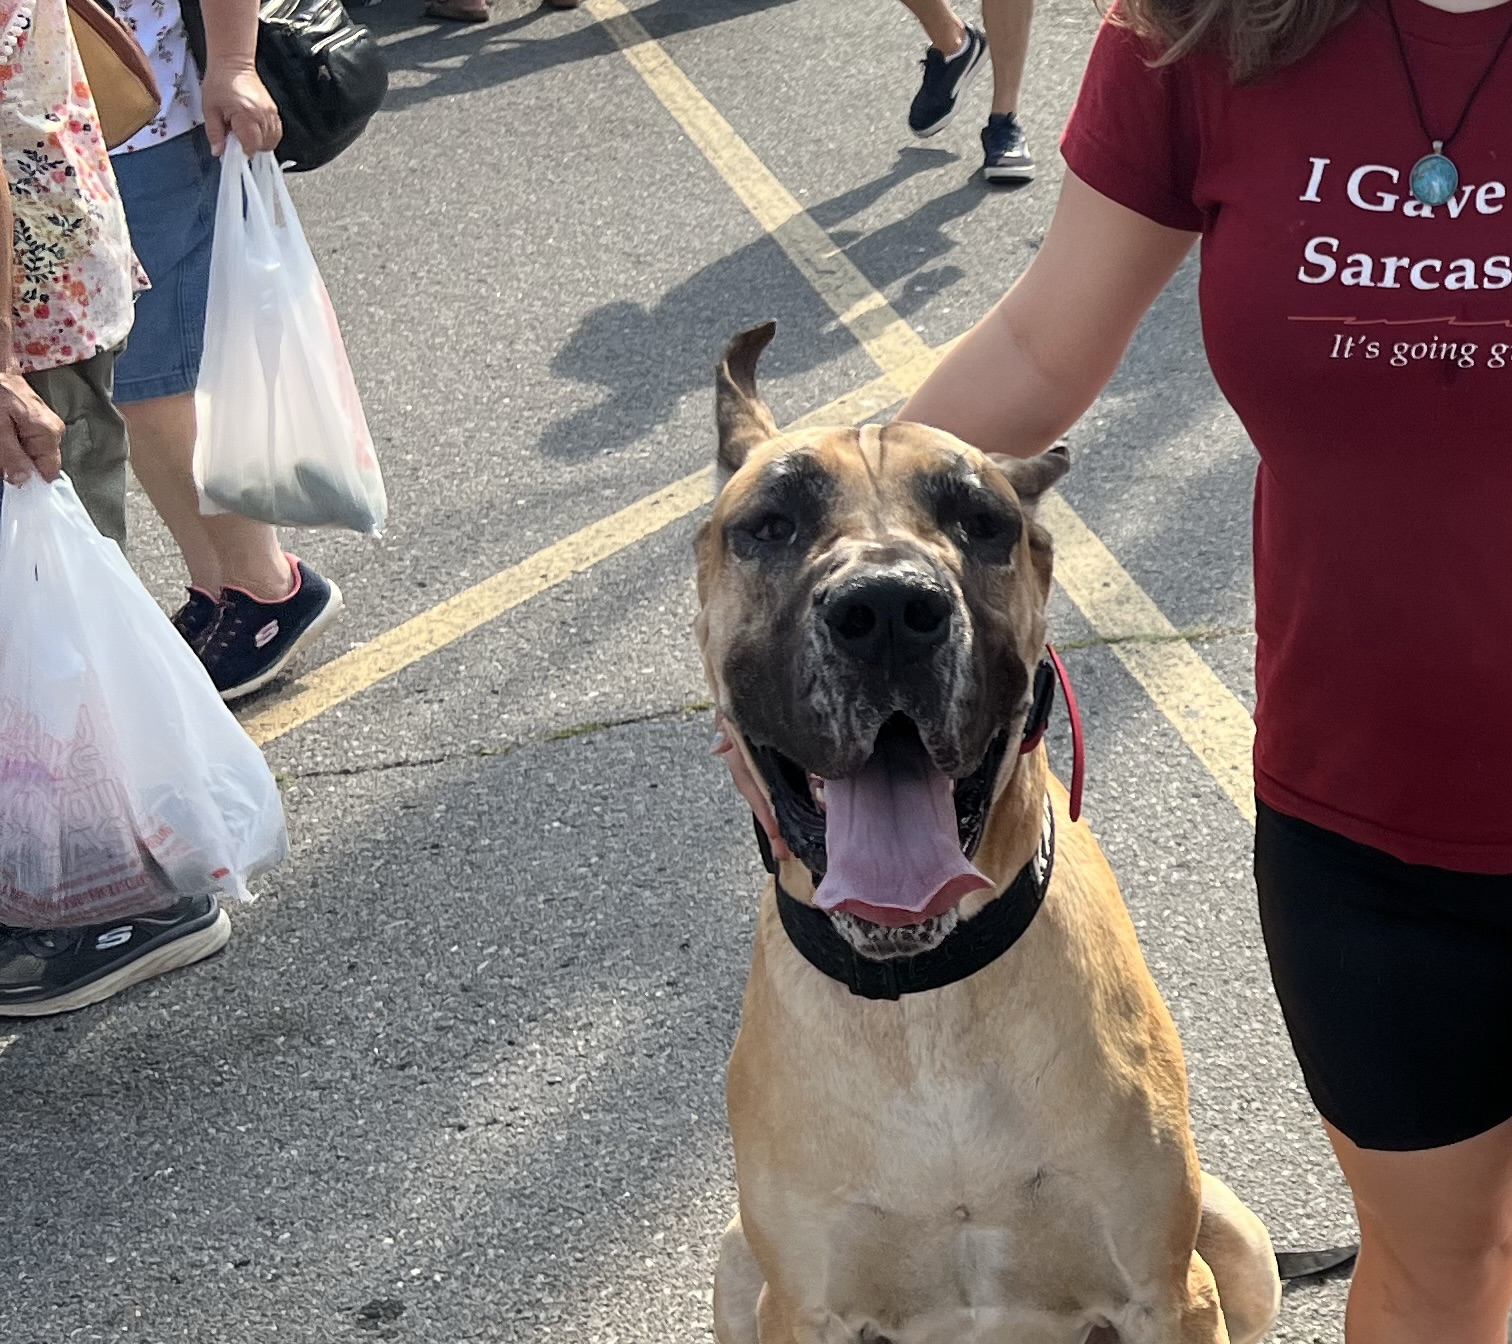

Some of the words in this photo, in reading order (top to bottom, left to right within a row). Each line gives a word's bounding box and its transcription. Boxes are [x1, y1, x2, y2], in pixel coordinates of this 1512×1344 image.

[1299, 157, 1331, 203] I
[1346, 164, 1506, 219] Gave
[1330, 333, 1380, 359] It's
[1389, 335, 1479, 368] going
